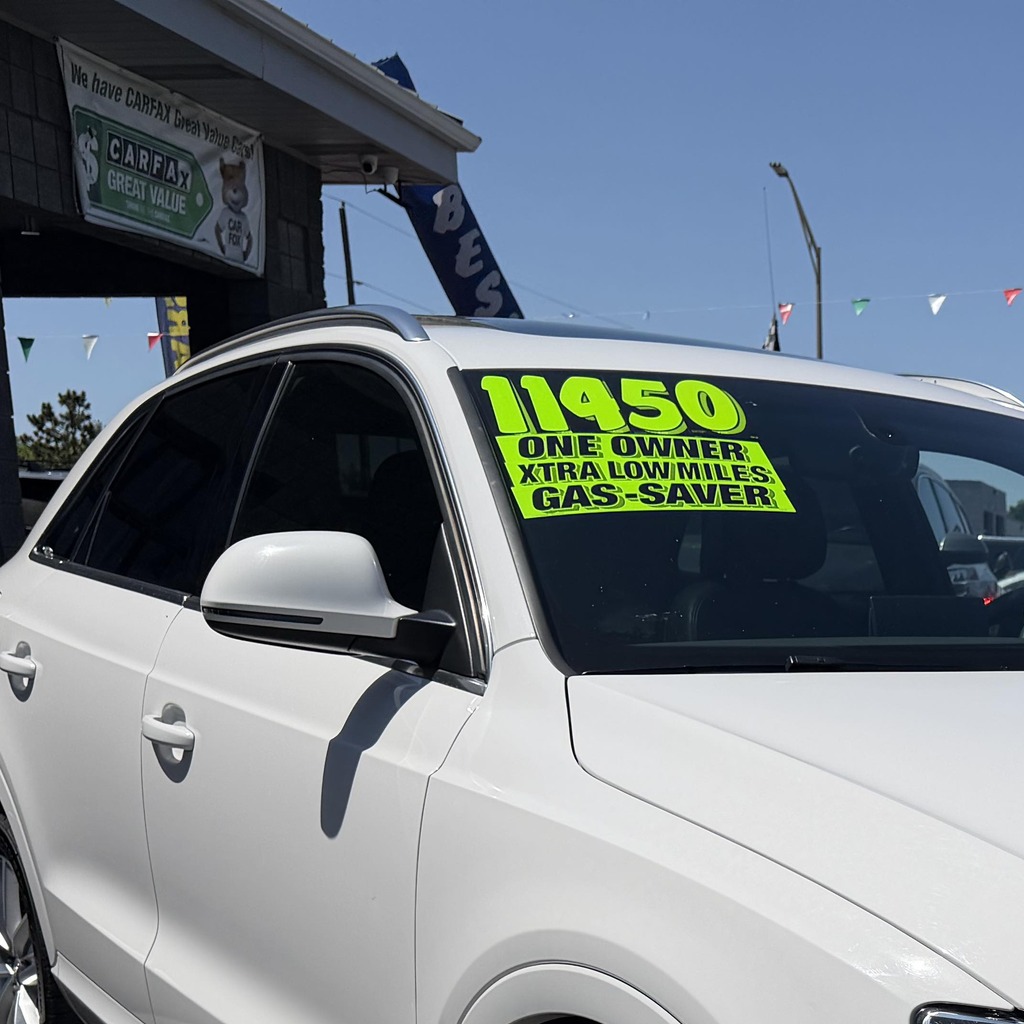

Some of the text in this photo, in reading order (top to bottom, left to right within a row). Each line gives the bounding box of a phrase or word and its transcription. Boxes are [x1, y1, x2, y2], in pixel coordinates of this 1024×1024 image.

[71, 62, 88, 88] We
[91, 73, 122, 102] have
[125, 87, 170, 124] CARFAX
[174, 111, 201, 138] Great
[202, 121, 230, 149] Value
[107, 135, 192, 191] CARFAX
[107, 169, 148, 201] GREAT
[150, 183, 187, 216] VALUE
[228, 217, 242, 233] CAR
[228, 232, 241, 247] FOX
[432, 184, 519, 318] BES
[517, 435, 750, 462] ONE OWNER
[519, 460, 775, 486] XTRA LOW MILES
[532, 483, 779, 512] GAS-SAVER
